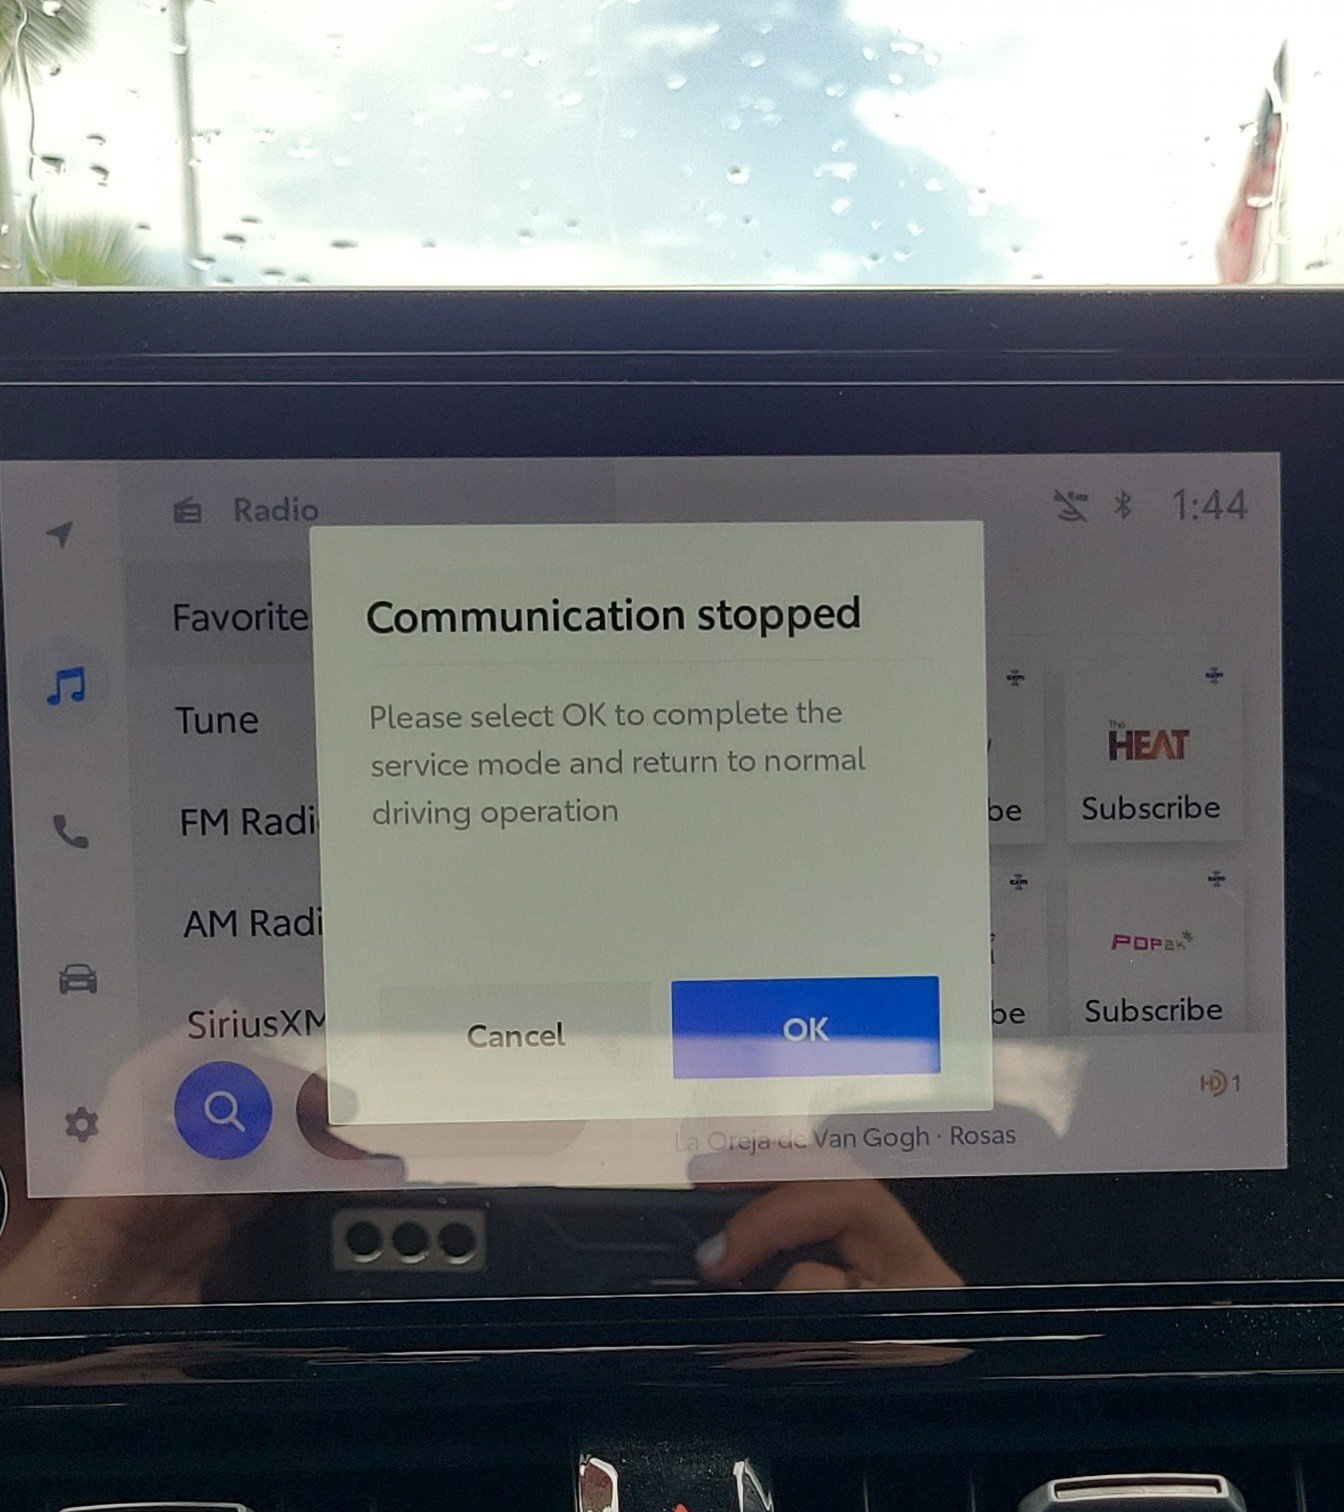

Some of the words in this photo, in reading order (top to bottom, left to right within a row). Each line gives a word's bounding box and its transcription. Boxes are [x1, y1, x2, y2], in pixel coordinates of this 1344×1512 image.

[233, 497, 320, 524] Radio
[1172, 488, 1249, 521] 1:44
[172, 601, 313, 632] Favorite
[366, 597, 686, 635] Communication
[697, 594, 862, 639] stopped
[174, 705, 260, 735] Tune
[370, 703, 463, 731] Please
[469, 702, 554, 730] select
[561, 701, 608, 727] OK
[615, 703, 645, 727] to
[652, 699, 789, 732] complete
[796, 698, 843, 725] the
[1108, 729, 1190, 761] HEAT
[371, 752, 470, 778] service
[477, 750, 561, 777] mode
[569, 748, 624, 776] and
[632, 749, 719, 774] return
[726, 749, 757, 772] to
[765, 745, 867, 773] normal
[180, 807, 230, 837] FM
[241, 805, 320, 836] Radi
[372, 800, 471, 831] driving
[481, 798, 620, 830] operation
[1081, 794, 1222, 821] Subscribe
[183, 909, 238, 939] AM
[249, 906, 323, 938] Radi
[187, 1008, 327, 1040] SiriusXM
[1084, 996, 1224, 1024] Subscribe
[466, 1022, 567, 1049] Cancel
[782, 1016, 831, 1043] OK
[707, 1131, 771, 1155] Oreja
[777, 1130, 807, 1149] de
[812, 1128, 857, 1149] Van
[863, 1125, 930, 1152] Gogh
[950, 1125, 1017, 1147] Rosas
